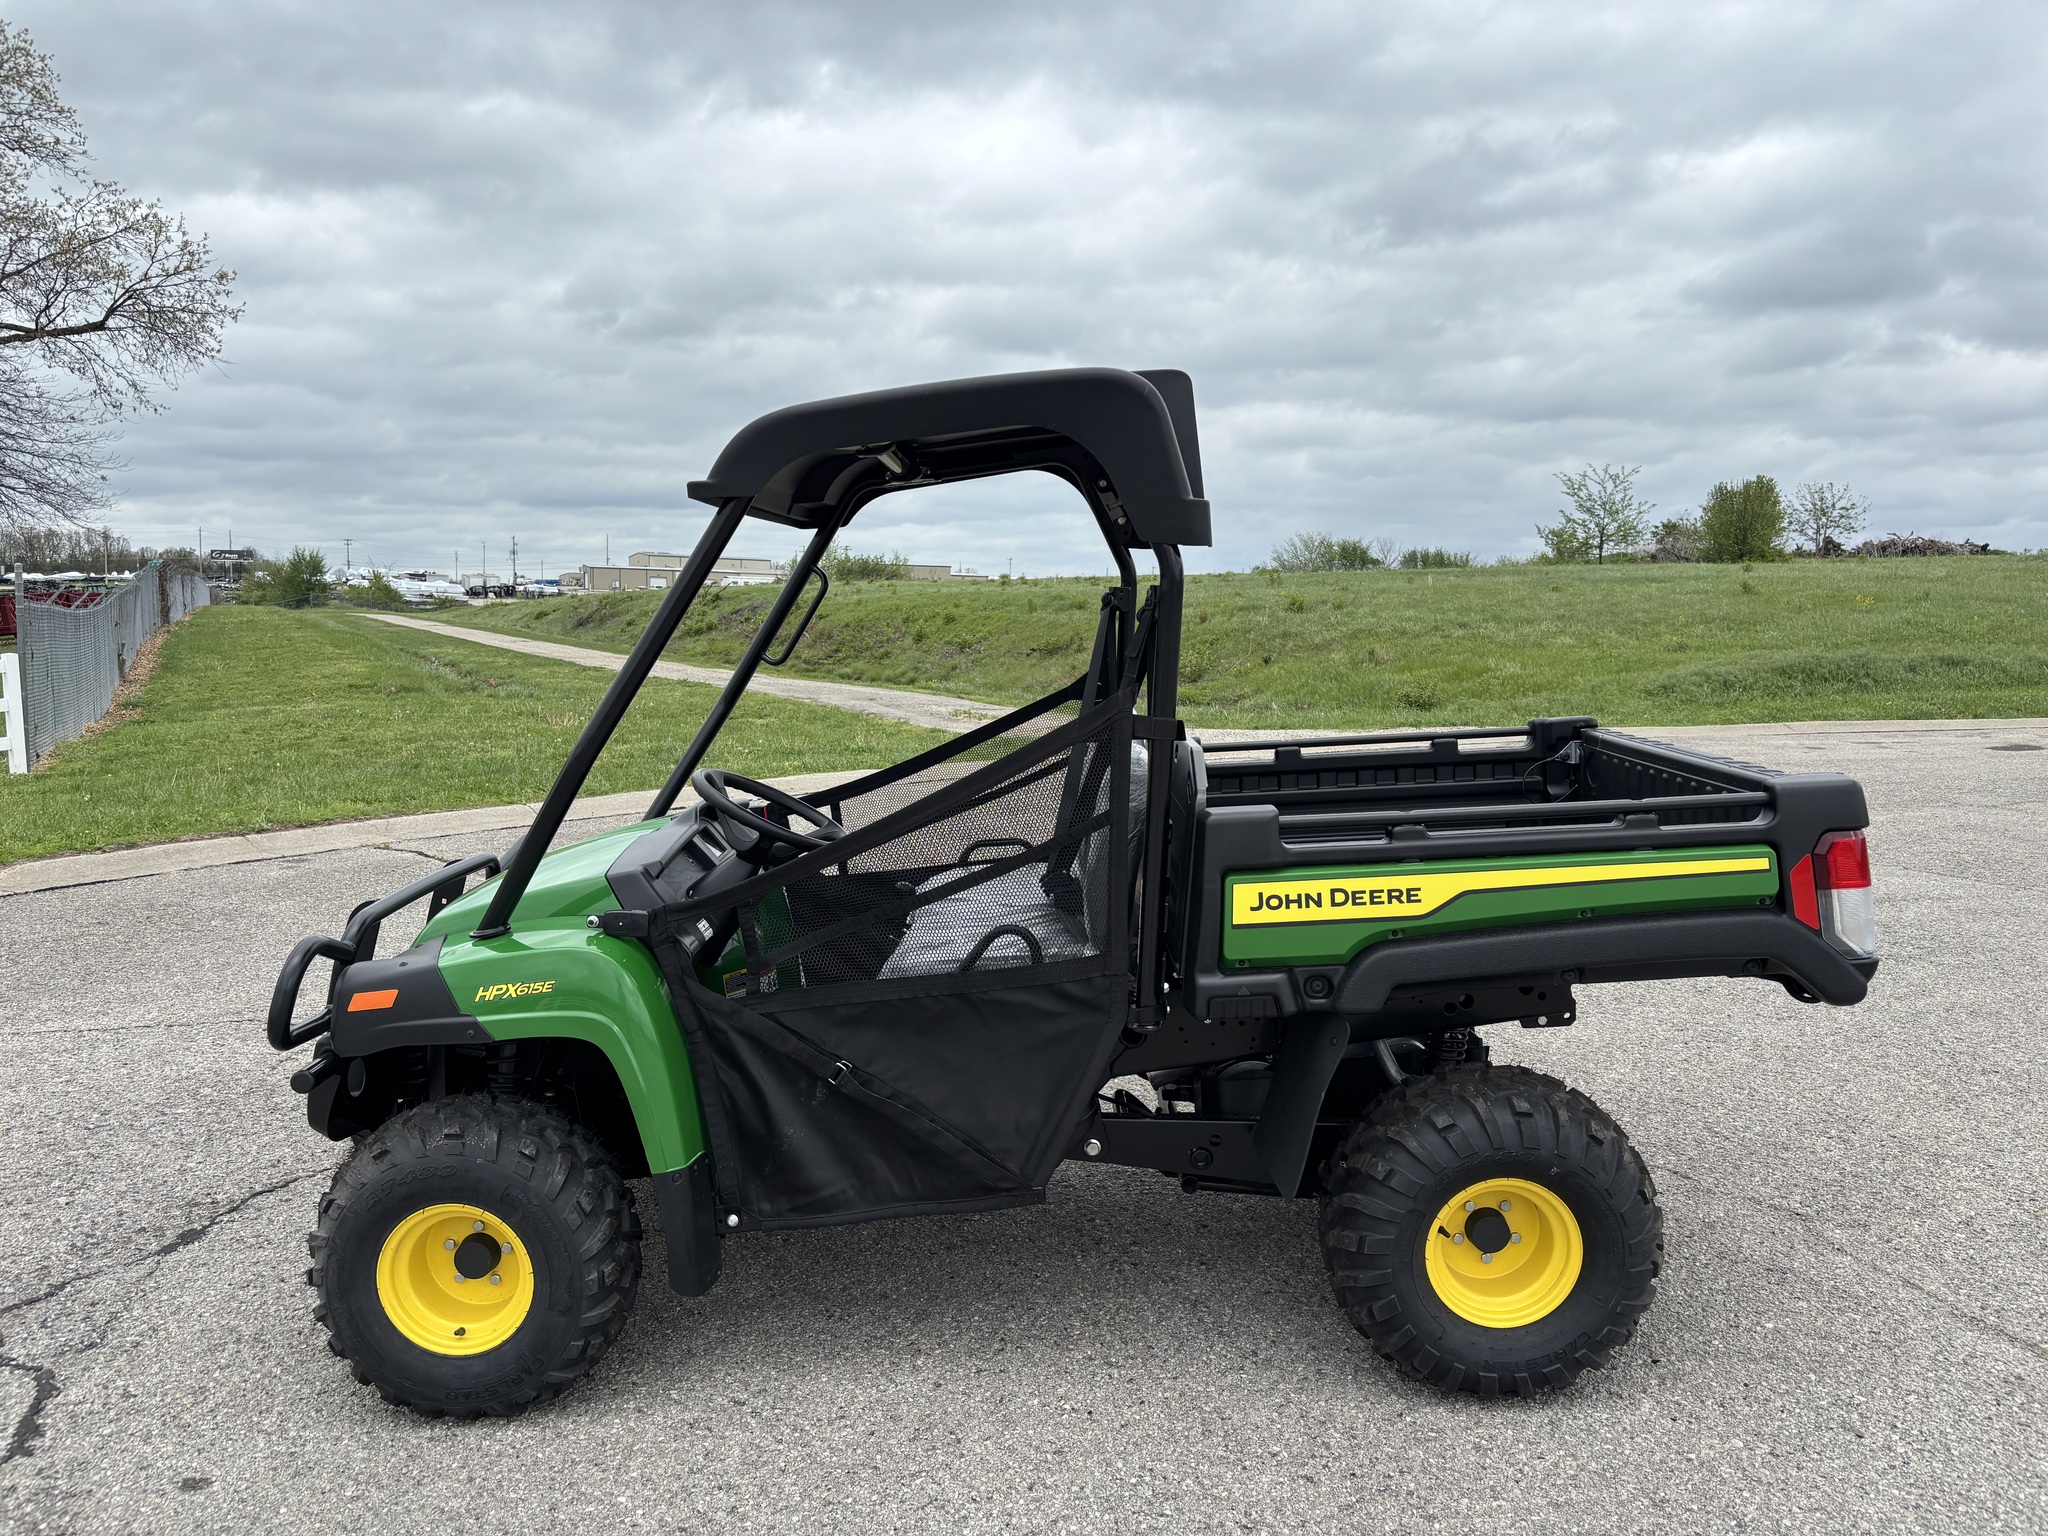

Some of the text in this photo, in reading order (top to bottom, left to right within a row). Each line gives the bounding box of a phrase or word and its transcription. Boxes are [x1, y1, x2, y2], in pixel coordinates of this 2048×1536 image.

[1250, 887, 1422, 911] JOHN DEERE
[475, 980, 556, 1003] HPX615E
